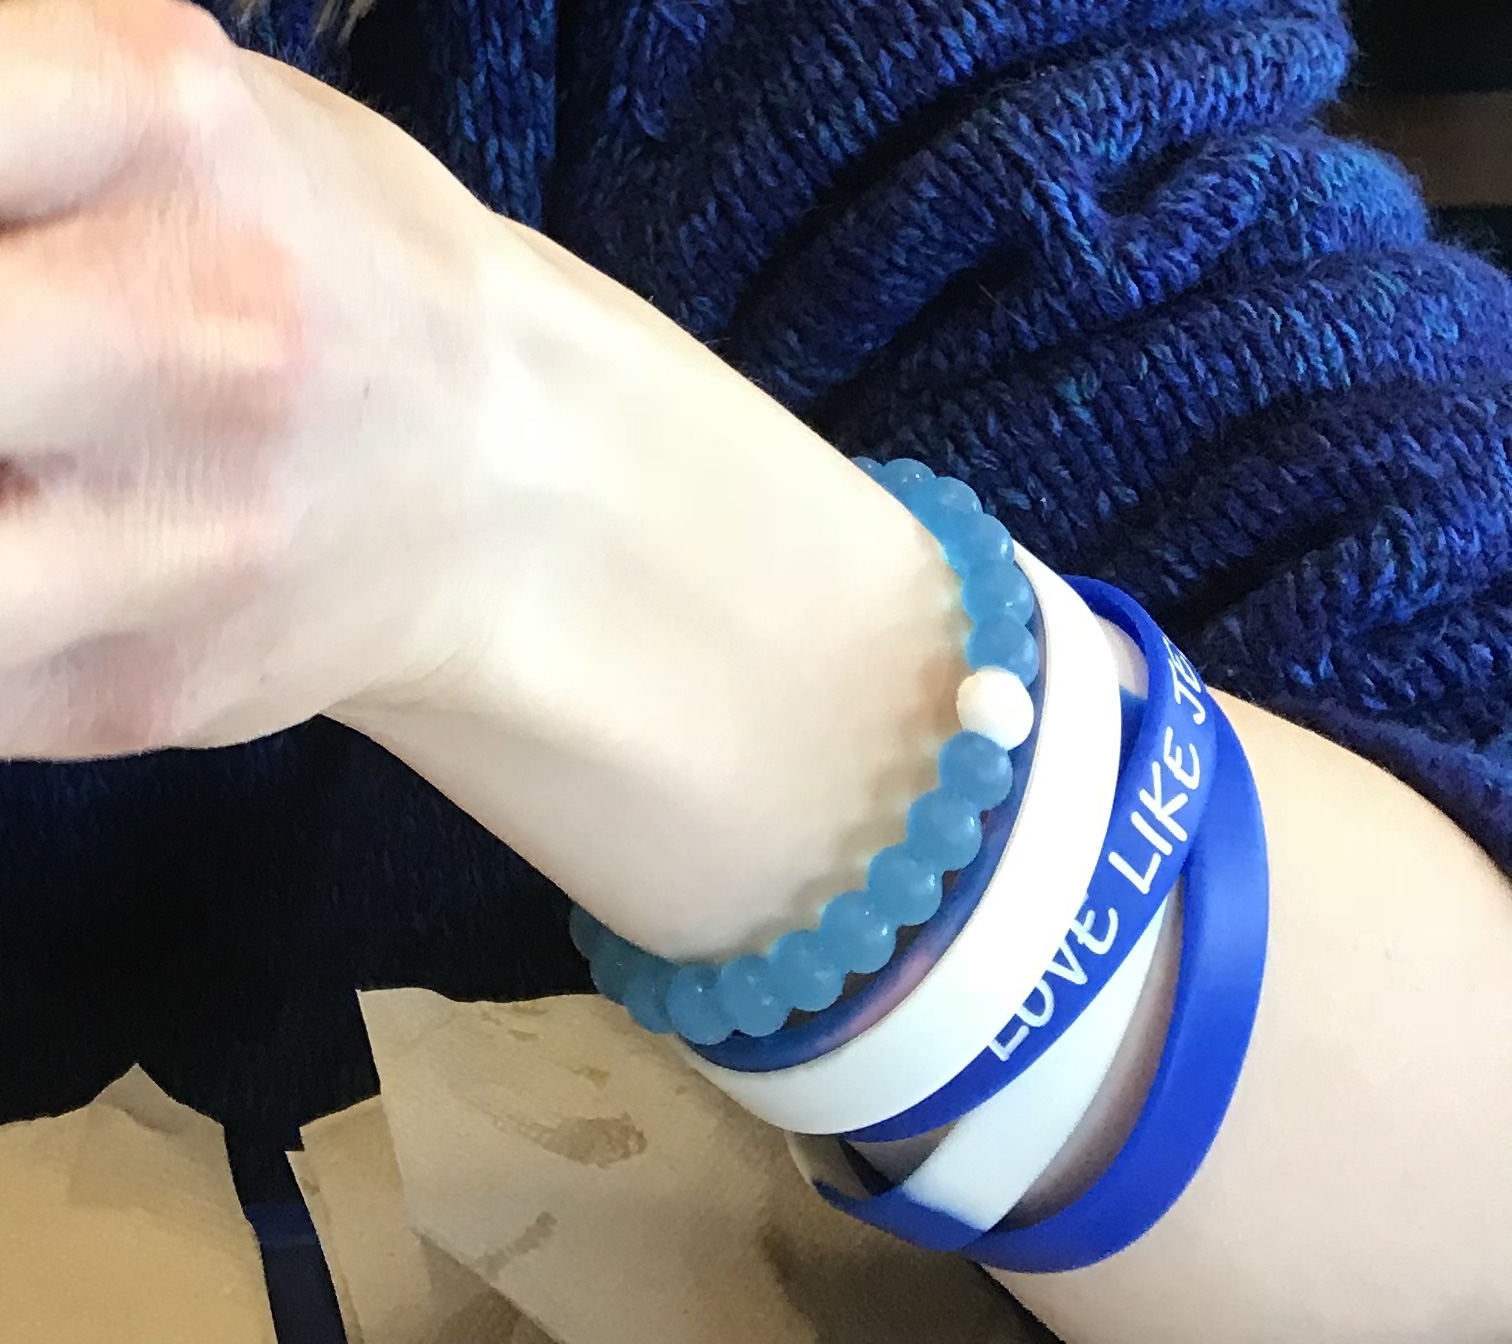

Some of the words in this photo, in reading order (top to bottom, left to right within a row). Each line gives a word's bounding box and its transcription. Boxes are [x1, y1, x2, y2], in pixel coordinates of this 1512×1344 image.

[989, 906, 1119, 1062] LOVE
[1108, 725, 1201, 894] LIKE
[1162, 636, 1206, 725] JE
